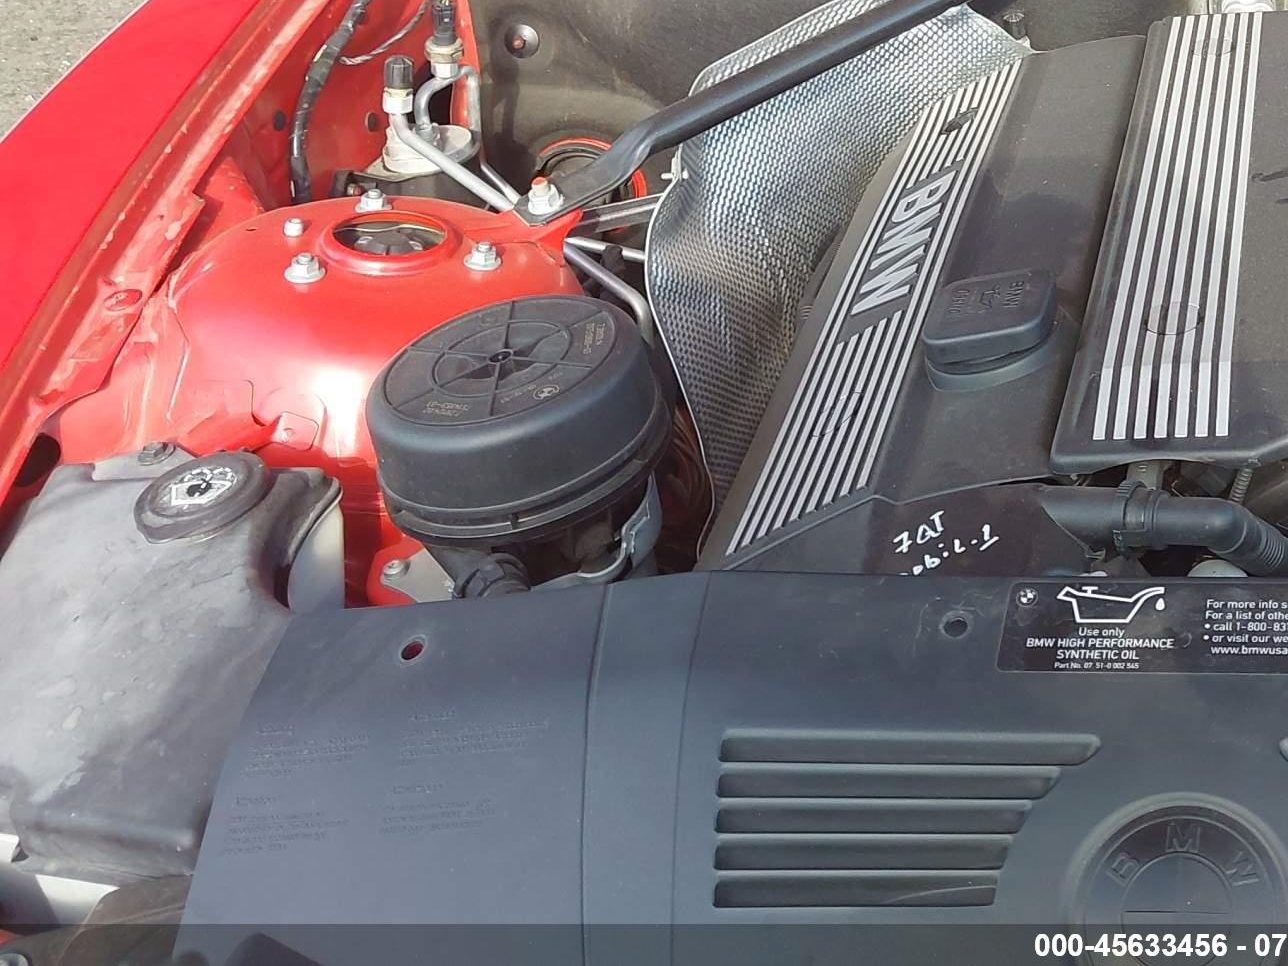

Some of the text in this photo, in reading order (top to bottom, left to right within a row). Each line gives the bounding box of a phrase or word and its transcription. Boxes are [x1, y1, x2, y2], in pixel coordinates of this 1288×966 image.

[850, 170, 957, 316] BMW
[1206, 599, 1225, 609] For
[1227, 600, 1256, 609] more
[1258, 599, 1278, 609] info
[1205, 611, 1223, 620] For
[1235, 611, 1252, 620] list
[1254, 611, 1265, 620] of
[1213, 622, 1232, 631] call
[1078, 627, 1125, 638] Use only
[1026, 638, 1175, 649] BMW HIGH PERFORMANCE
[1212, 635, 1224, 643] or
[1226, 634, 1249, 643] visit
[1056, 650, 1140, 660] SYNTHETIC OIL
[1105, 820, 1260, 887] BMW
